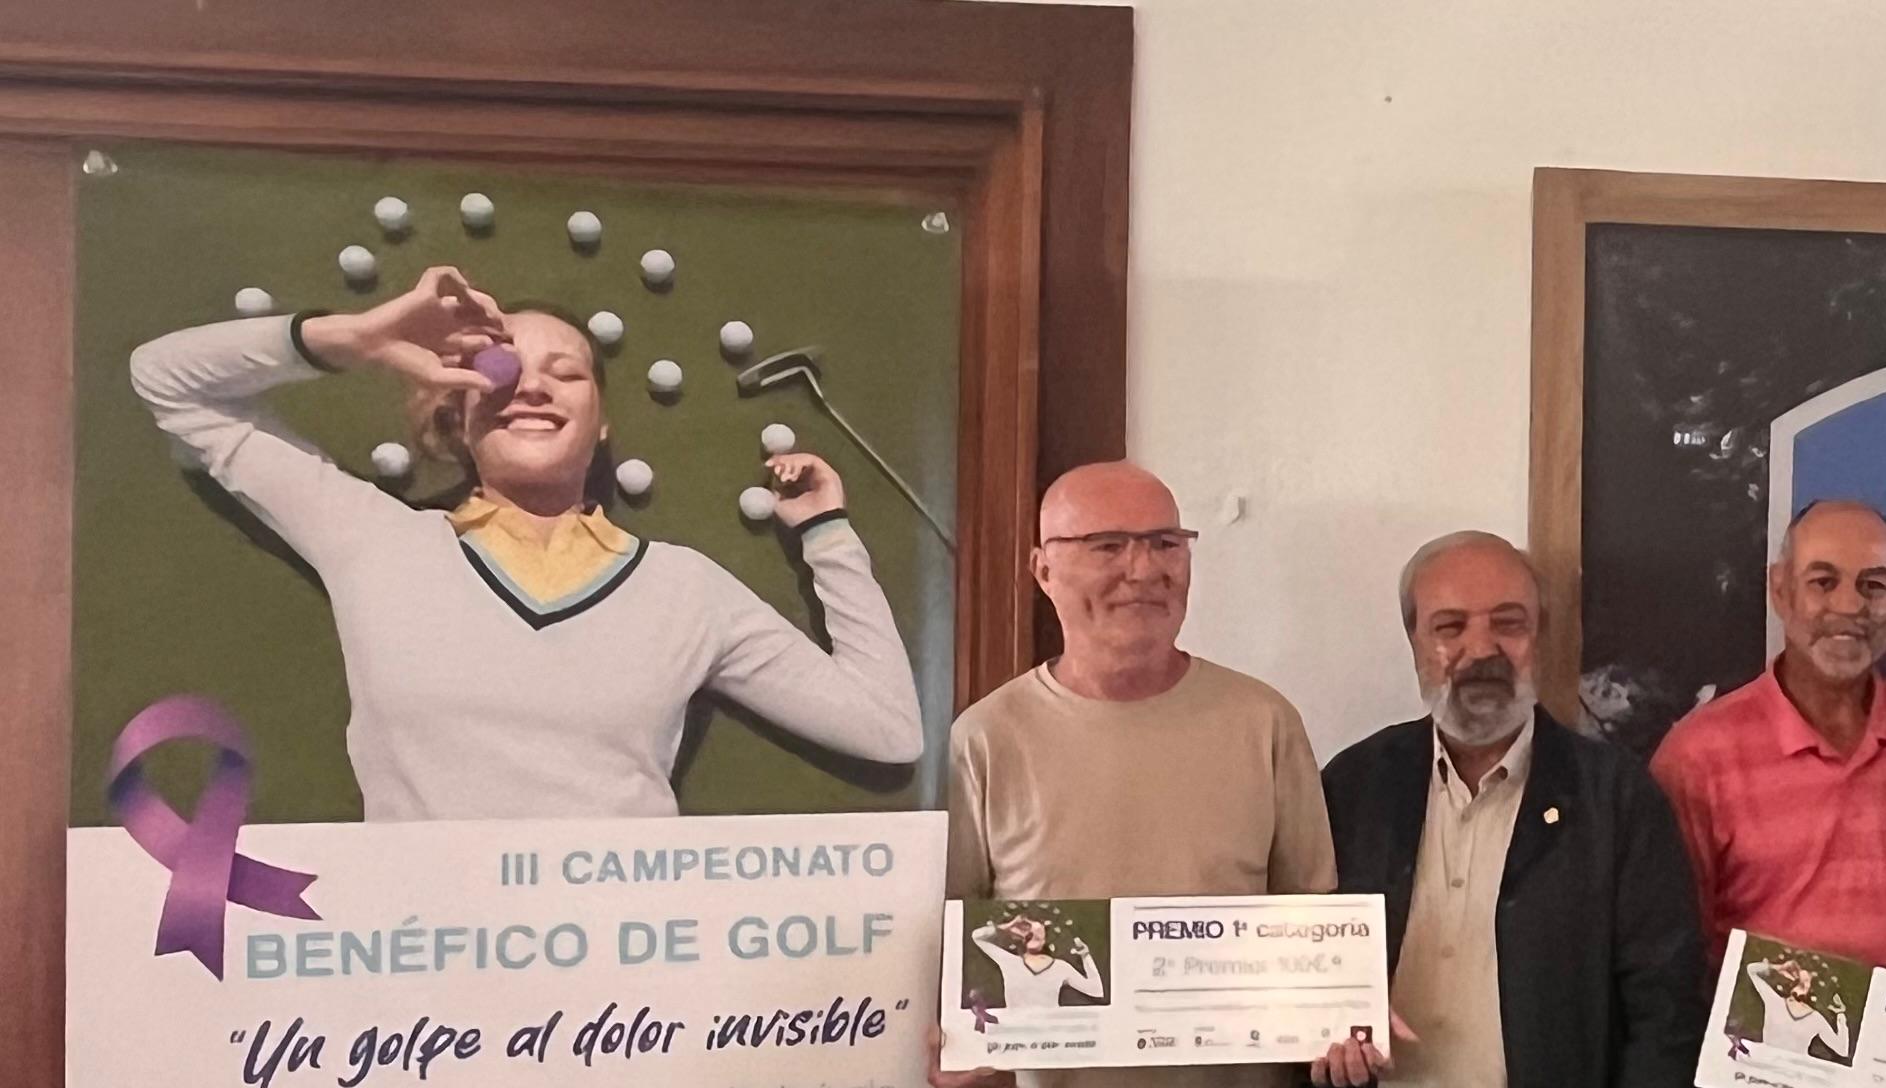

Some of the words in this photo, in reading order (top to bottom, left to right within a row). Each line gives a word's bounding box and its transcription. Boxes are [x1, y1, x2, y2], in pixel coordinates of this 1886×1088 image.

[501, 852, 539, 886] III
[562, 843, 894, 885] CAMPEONATO
[246, 915, 589, 980] BENÉFICO
[618, 918, 700, 966] DE
[727, 912, 894, 961] GOLF
[1132, 920, 1224, 941] PREMIO
[336, 1015, 482, 1088] golpe
[506, 1009, 564, 1063] al
[572, 1002, 686, 1067] dolor
